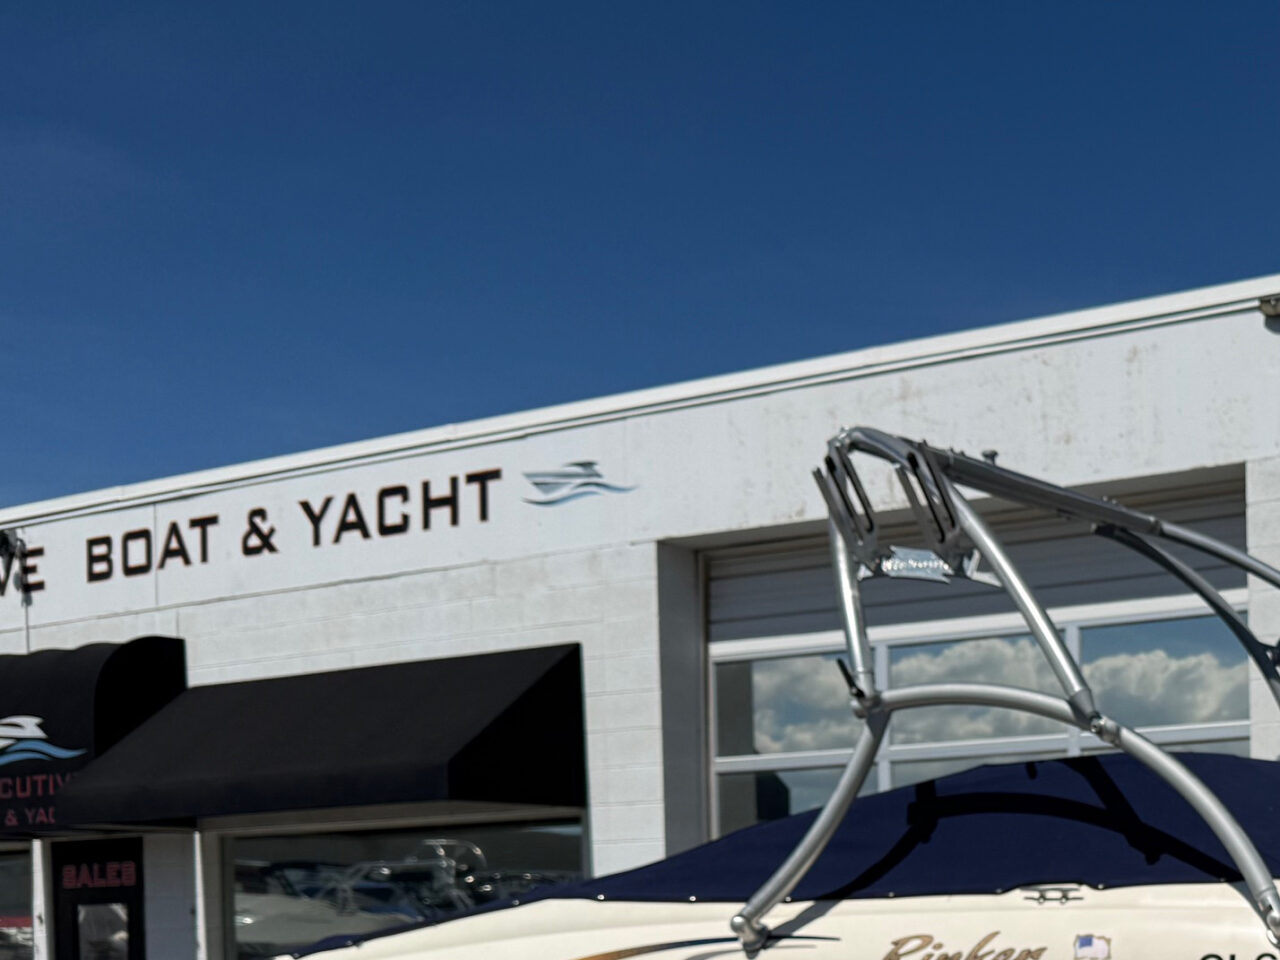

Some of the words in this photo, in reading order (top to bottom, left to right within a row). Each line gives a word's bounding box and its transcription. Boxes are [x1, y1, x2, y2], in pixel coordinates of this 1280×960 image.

[86, 514, 219, 583] BOAT
[242, 507, 279, 557] &
[298, 467, 502, 547] YACHT
[4, 808, 19, 827] &
[62, 861, 136, 889] SALES
